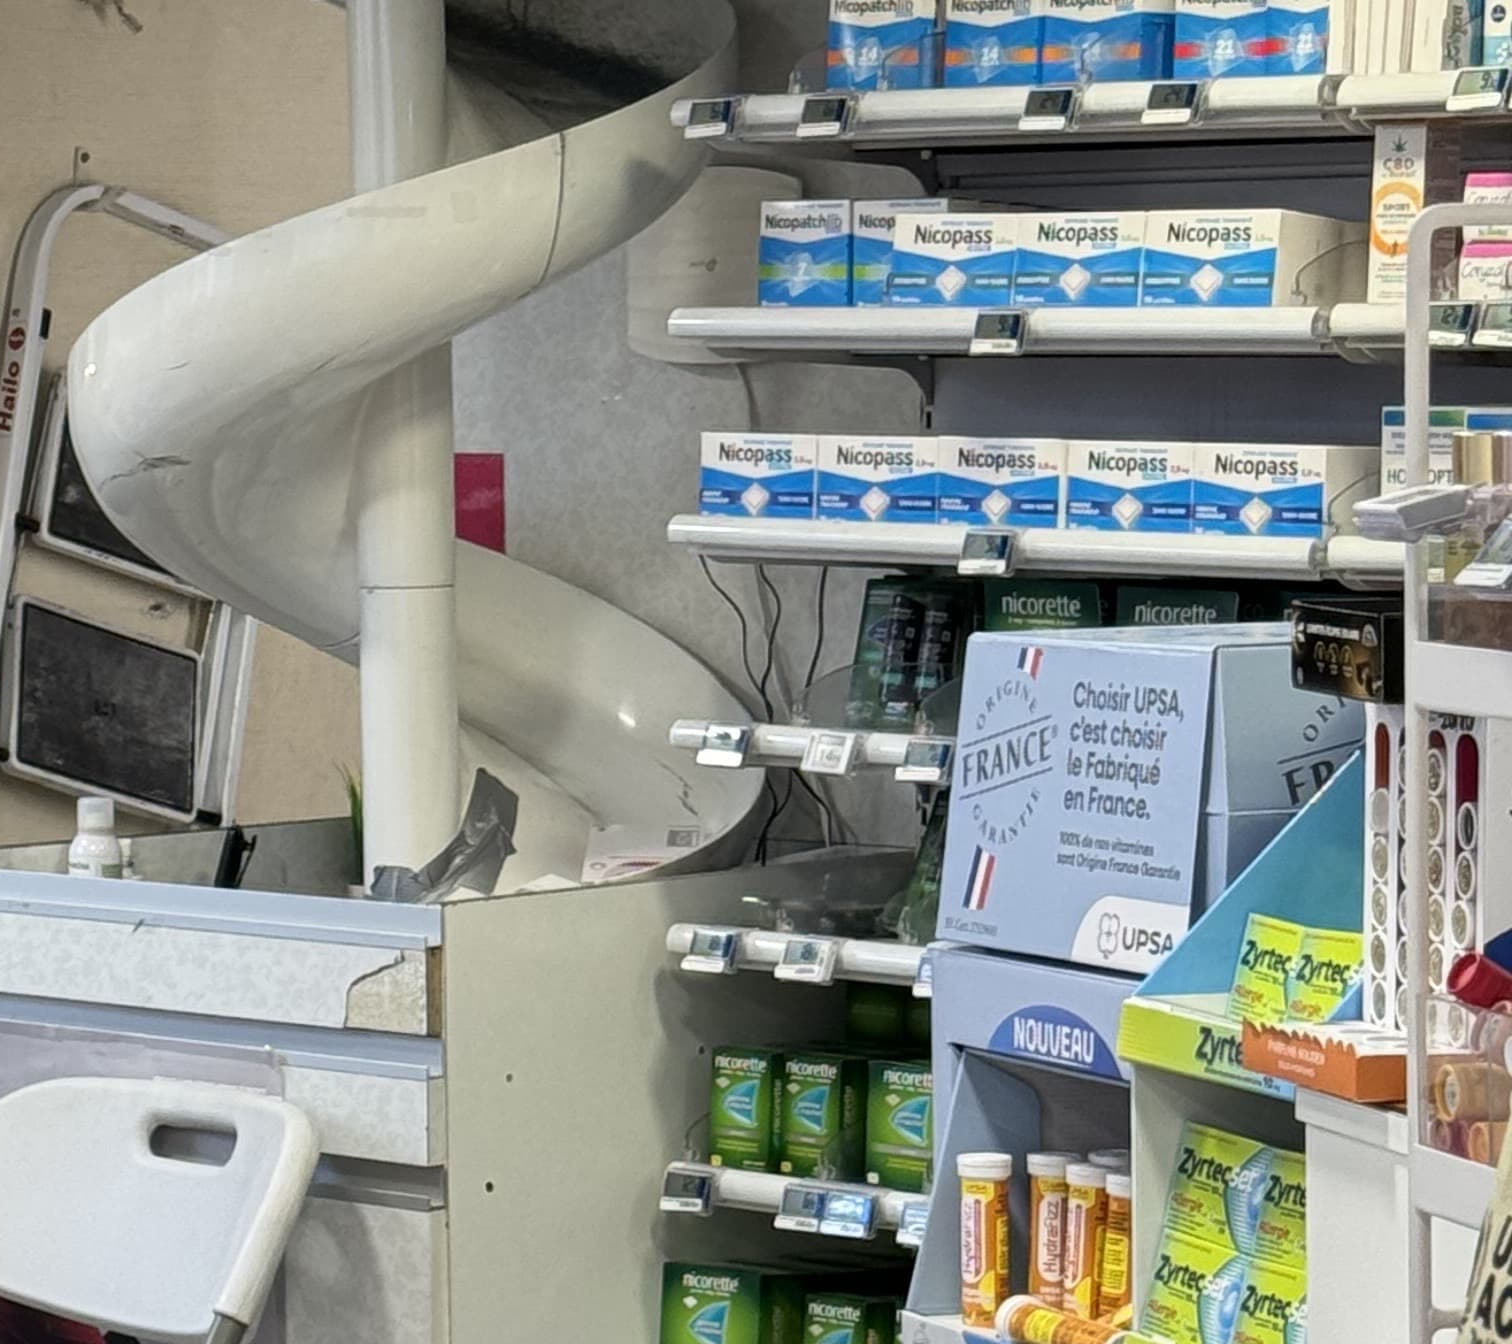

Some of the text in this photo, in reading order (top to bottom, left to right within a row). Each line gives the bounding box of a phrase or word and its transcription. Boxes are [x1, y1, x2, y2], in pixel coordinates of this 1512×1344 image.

[914, 224, 992, 249] Nicopass
[1038, 221, 1119, 248] Nicopass
[1168, 221, 1252, 249] Nicopass
[719, 442, 792, 466] Nicopass
[837, 445, 913, 469] Nicopass
[958, 447, 1035, 473] Nicopass
[1088, 451, 1168, 476] Nicopass
[1215, 453, 1298, 480] Nicopass
[1002, 592, 1082, 617] nicorette
[1135, 600, 1217, 625] nicorette
[1073, 681, 1184, 723] Choisir UPSA,
[1070, 716, 1167, 751] c'est choisir
[1067, 749, 1161, 790] le Fabriqué
[1064, 786, 1151, 820] en France.
[1122, 925, 1174, 956] UPSA
[1240, 939, 1293, 978] Zyrtec
[1013, 1017, 1095, 1064] NOUVEAU
[715, 1054, 768, 1074] nicorette
[786, 1059, 838, 1080] nicorette
[683, 1272, 739, 1293] nicorette
[808, 1300, 861, 1323] nicorette
[1240, 1285, 1307, 1324] Zyrtecse
